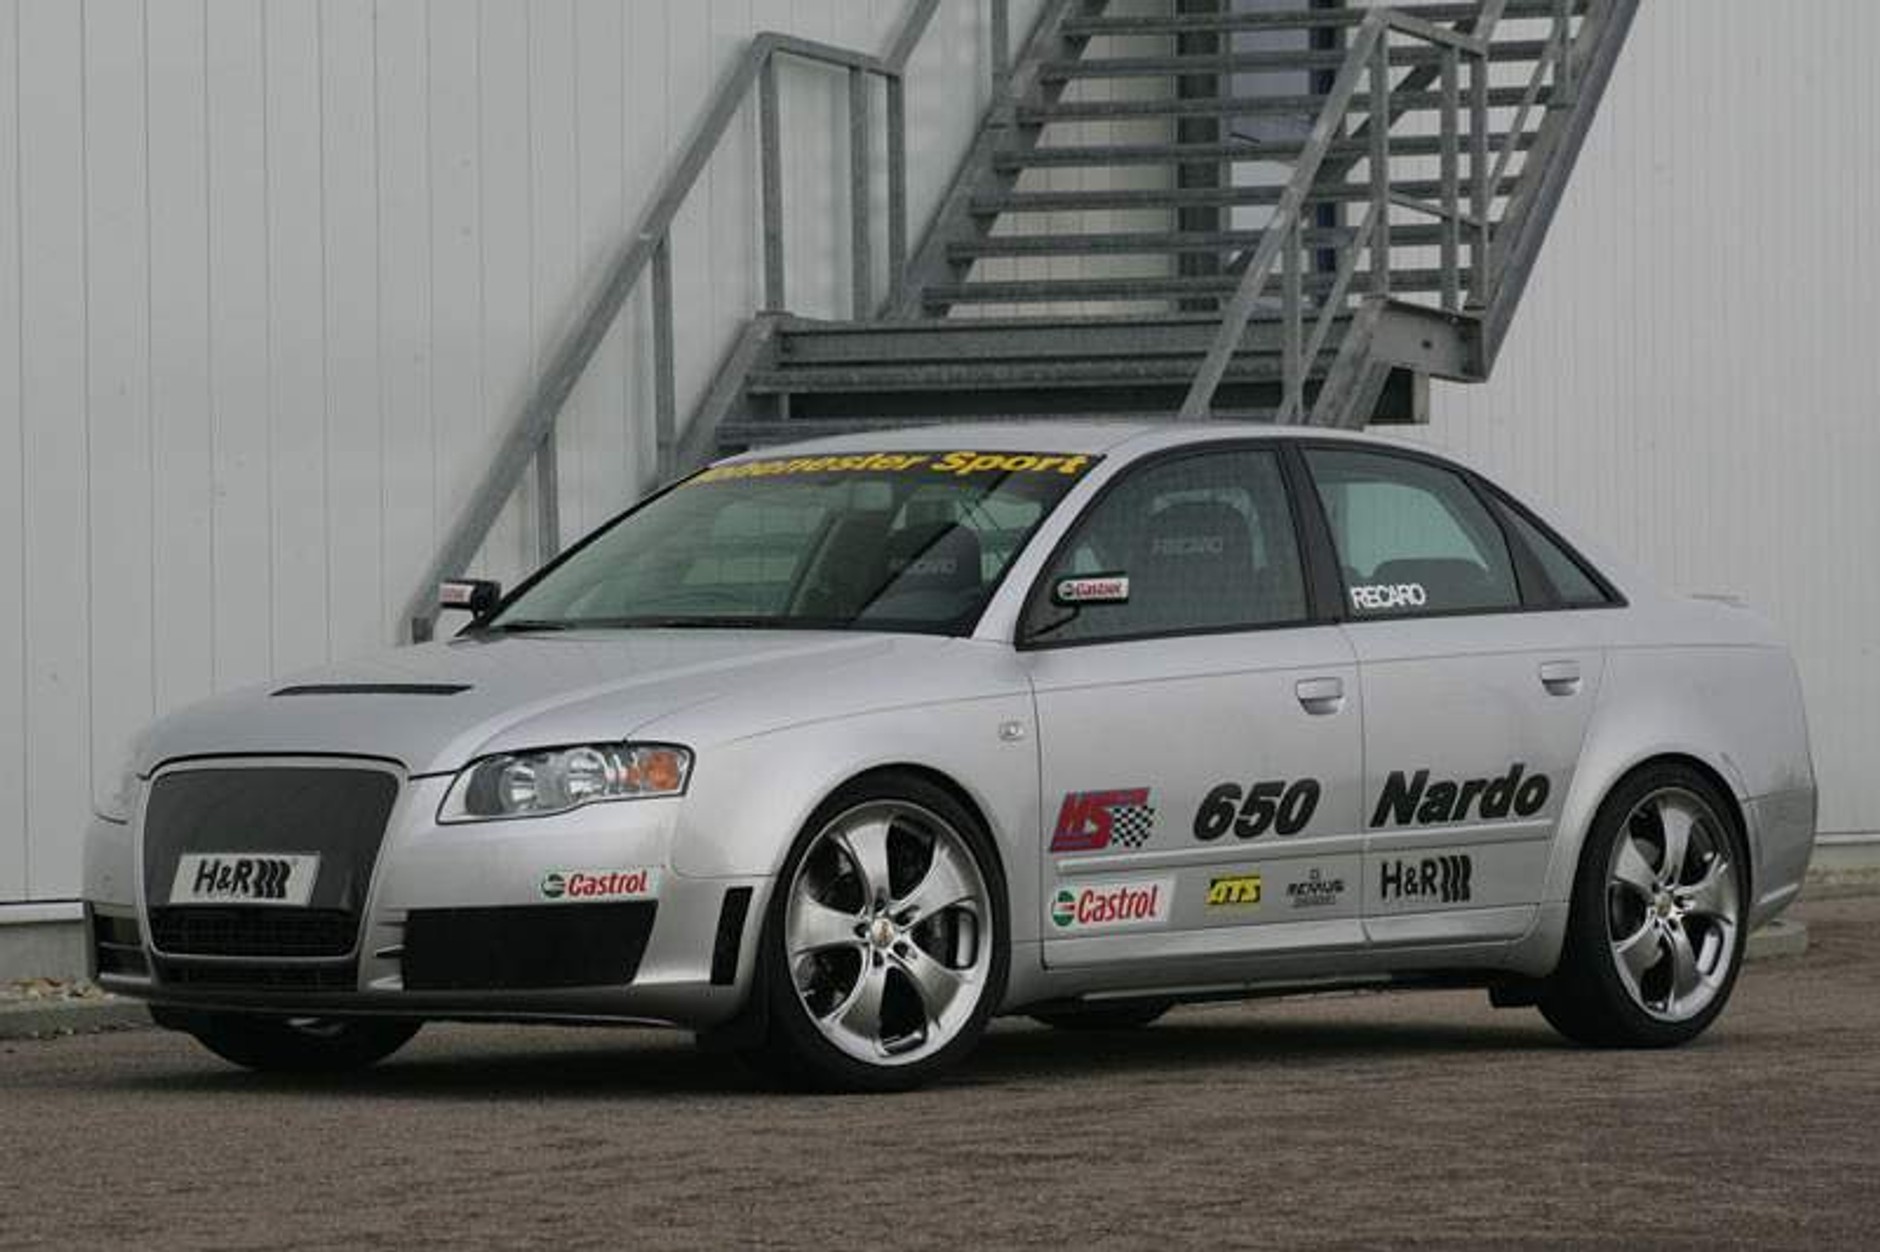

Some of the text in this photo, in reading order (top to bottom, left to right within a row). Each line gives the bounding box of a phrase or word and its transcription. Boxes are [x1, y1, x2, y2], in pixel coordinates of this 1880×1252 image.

[931, 452, 1086, 476] Sport
[1350, 583, 1426, 609] RECARO
[1193, 778, 1320, 841] 650
[1368, 763, 1551, 828] Nardo
[567, 869, 648, 897] Castrol
[1207, 877, 1261, 904] ATS
[1077, 884, 1158, 925] Castrol
